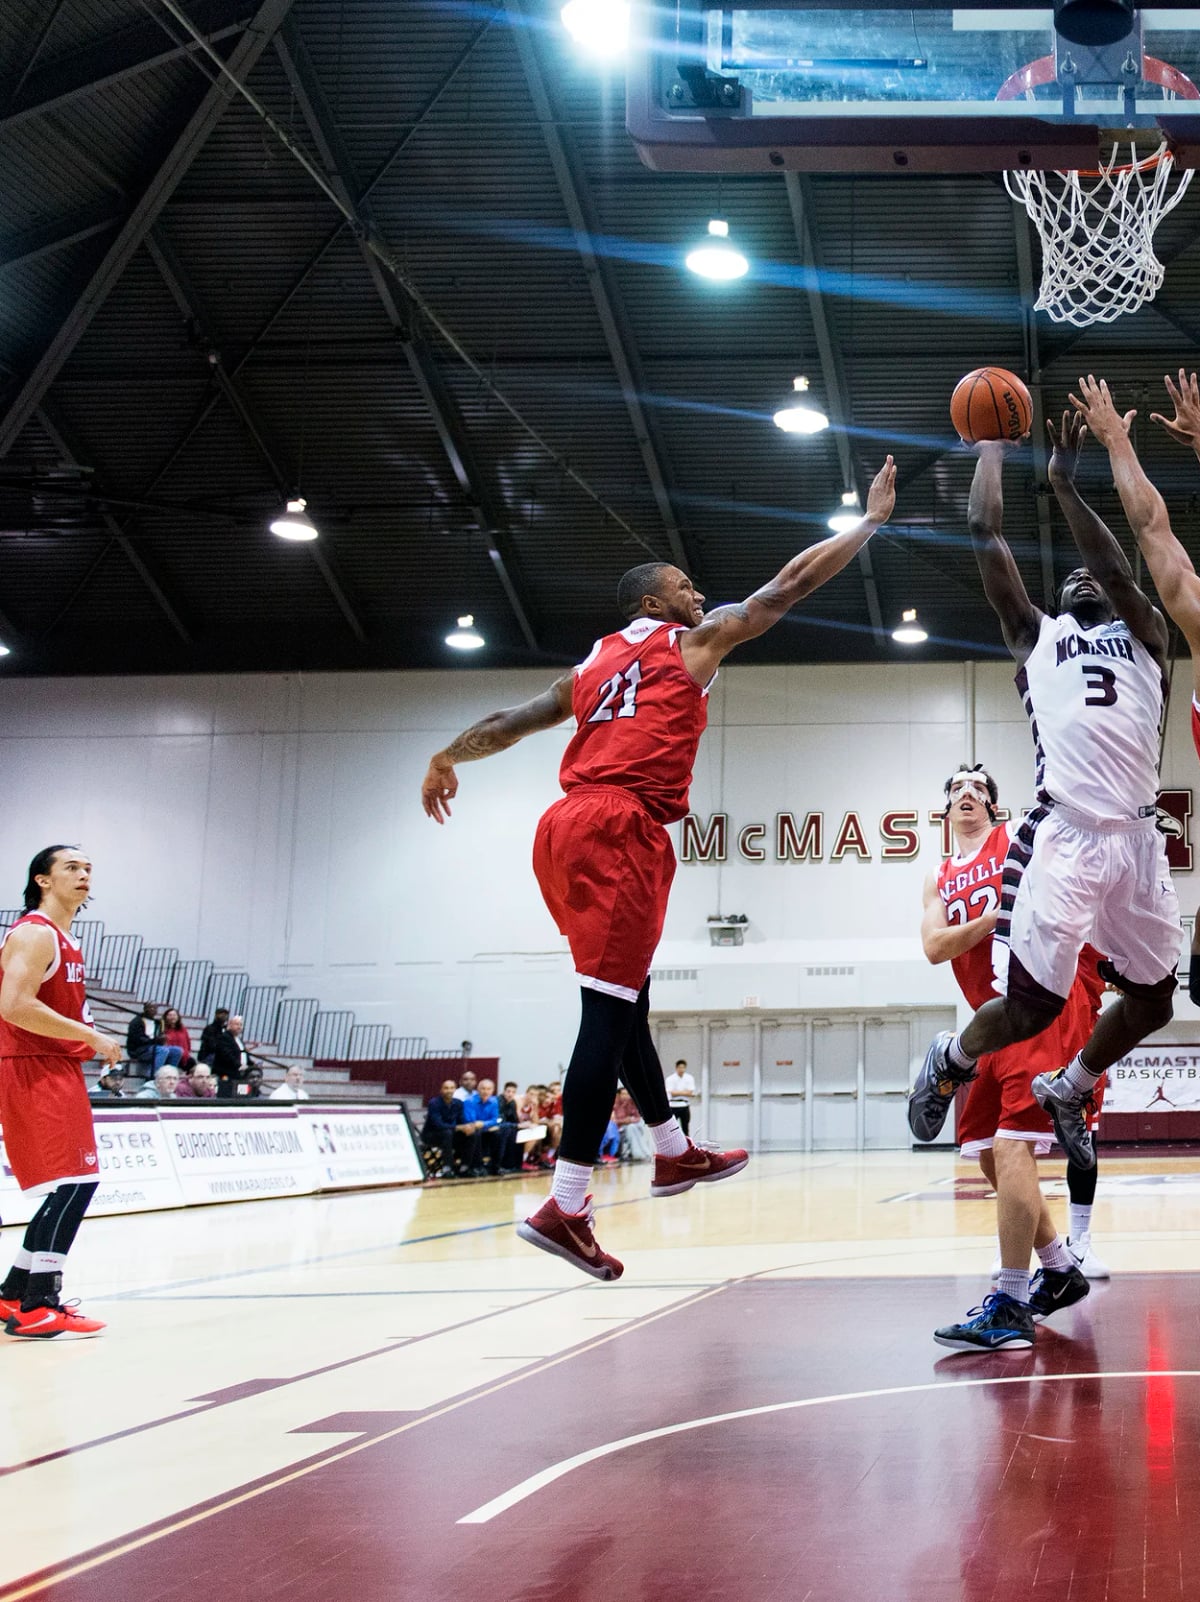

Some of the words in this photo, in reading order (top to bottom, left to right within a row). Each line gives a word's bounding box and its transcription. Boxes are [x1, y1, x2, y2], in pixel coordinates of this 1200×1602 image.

[586, 659, 642, 725] 21
[1082, 665, 1118, 706] 3
[681, 809, 1032, 861] McMAST
[97, 1132, 154, 1149] STER
[175, 1132, 235, 1158] BURRIDGE
[234, 1130, 303, 1156] GYMNASIUM
[333, 1123, 402, 1137] McMASTER
[98, 1154, 158, 1169] UDERS
